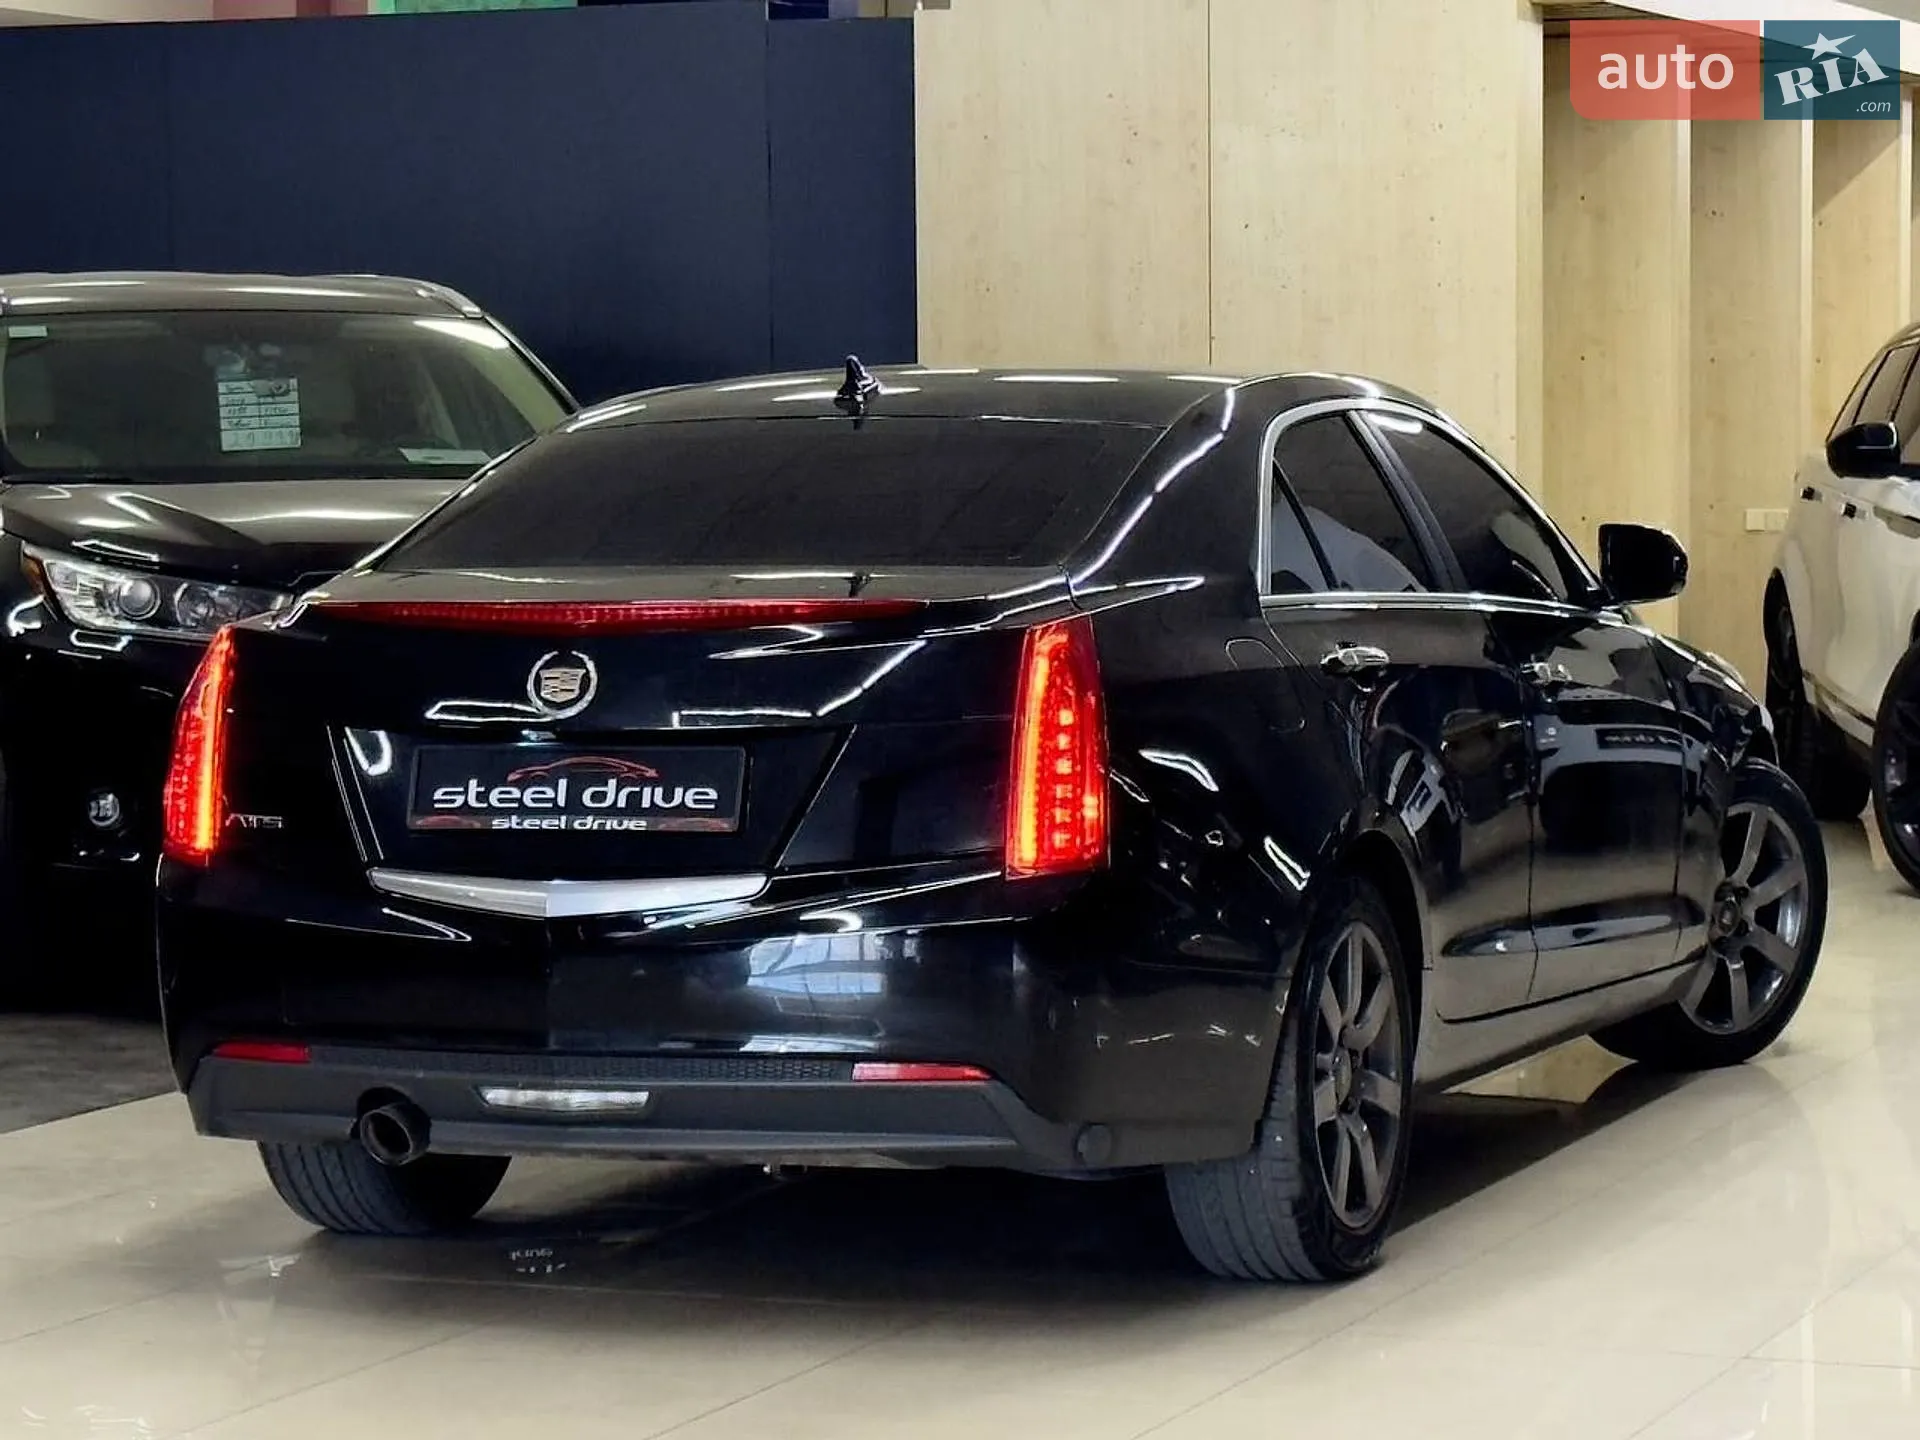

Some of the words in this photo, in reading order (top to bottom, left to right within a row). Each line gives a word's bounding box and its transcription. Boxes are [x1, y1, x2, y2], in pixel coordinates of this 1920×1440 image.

[433, 778, 567, 809] steel
[582, 778, 719, 810] drive
[491, 814, 567, 831] steel
[572, 815, 649, 832] drive
